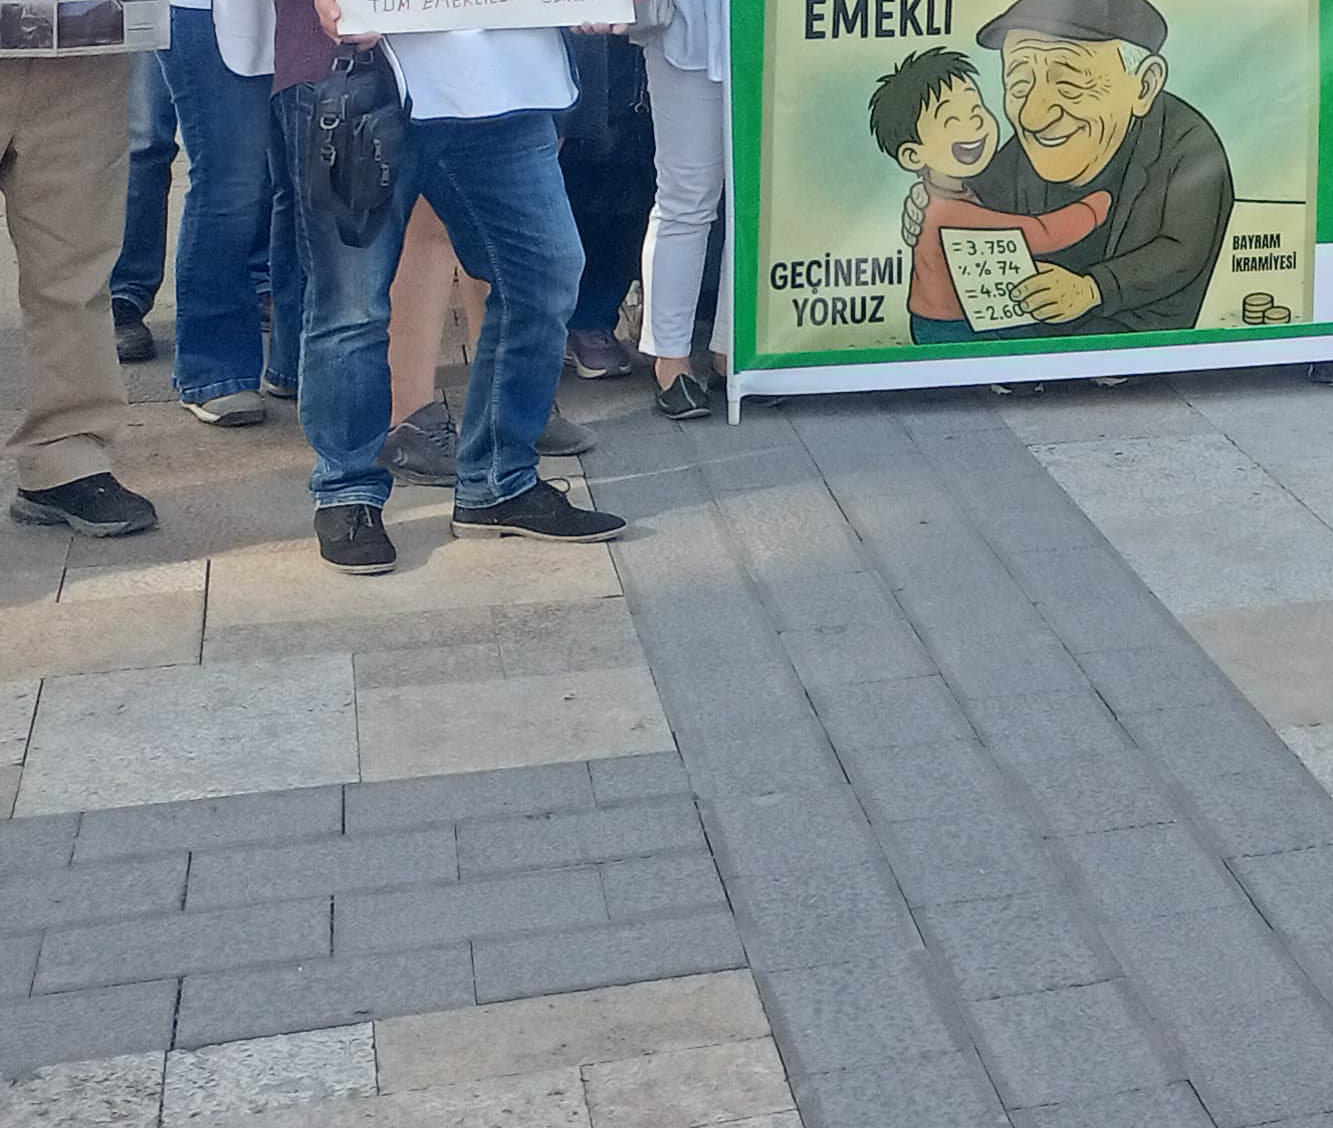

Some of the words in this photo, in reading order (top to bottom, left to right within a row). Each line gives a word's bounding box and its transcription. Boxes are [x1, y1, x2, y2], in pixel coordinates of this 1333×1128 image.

[1232, 233, 1281, 251] BAYRAM
[770, 248, 903, 294] GEÇİNEMİ
[996, 260, 1020, 276] 74
[1232, 251, 1296, 272] İKRAMİYESİ
[792, 294, 885, 328] YORUZ
